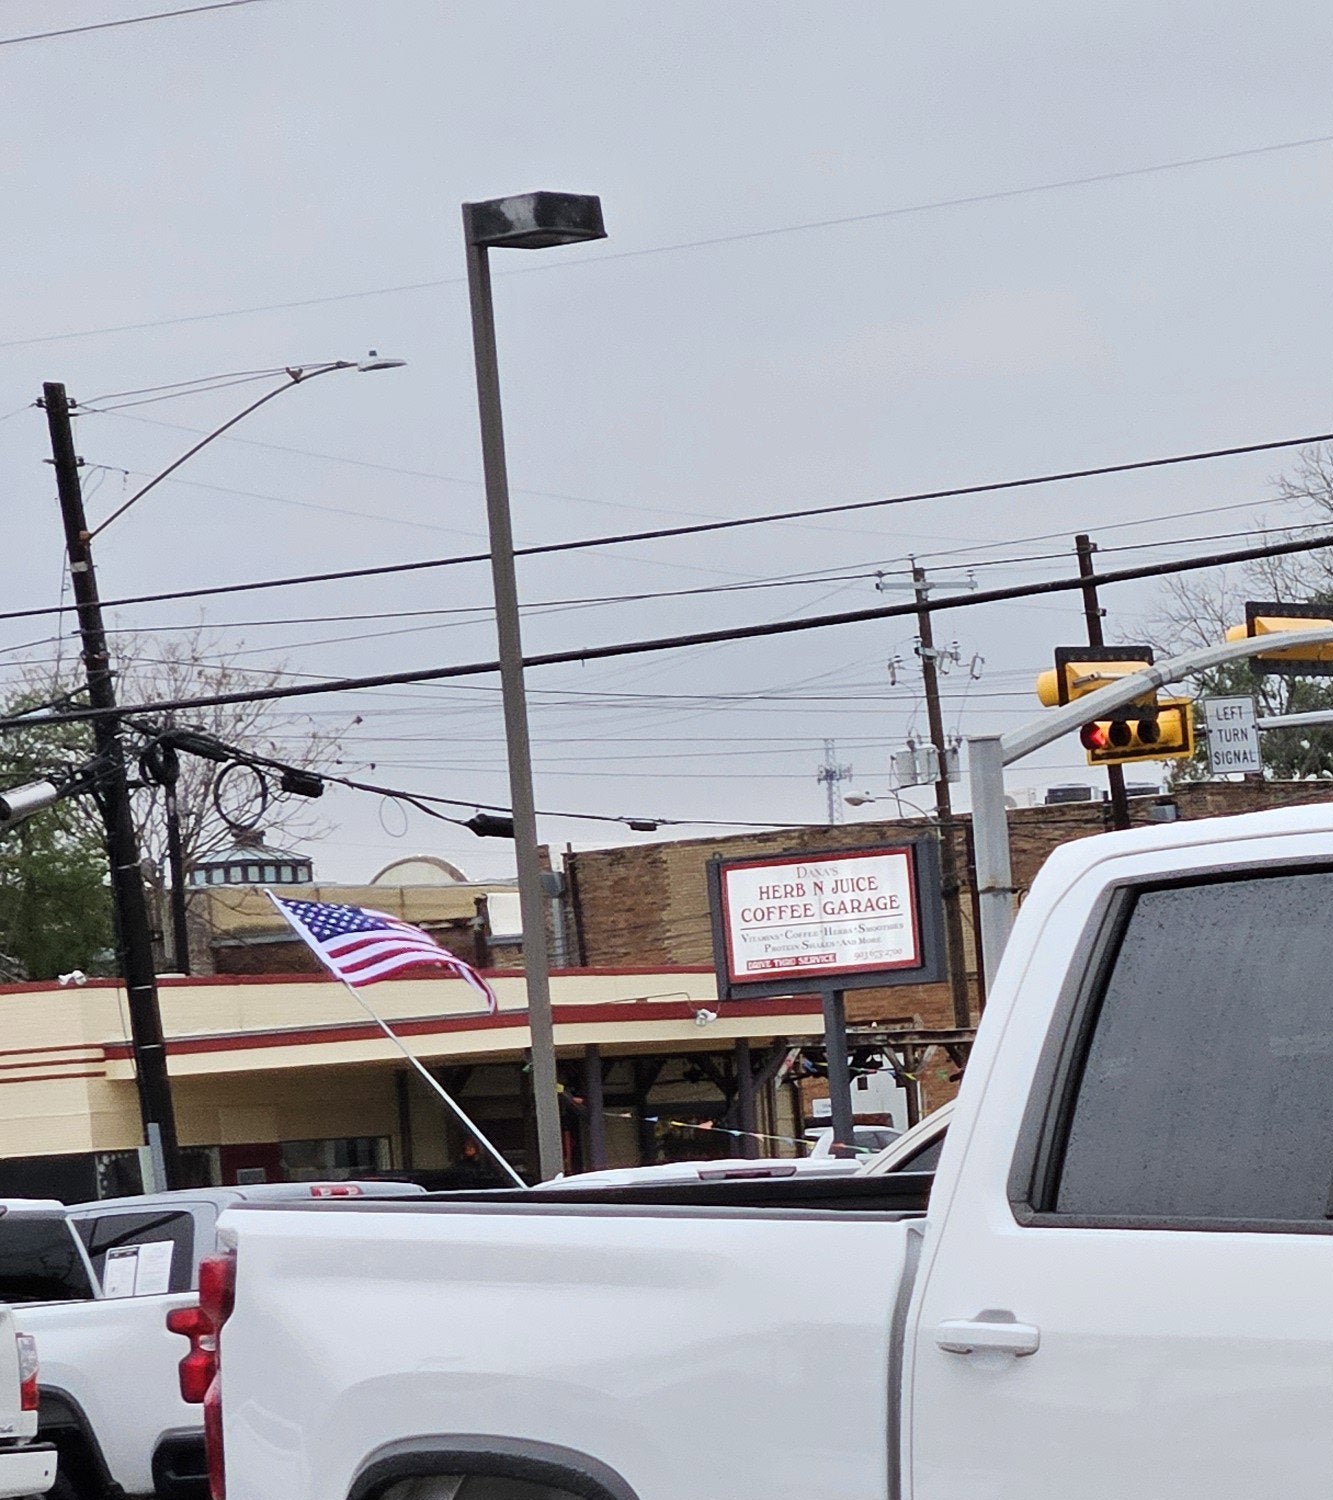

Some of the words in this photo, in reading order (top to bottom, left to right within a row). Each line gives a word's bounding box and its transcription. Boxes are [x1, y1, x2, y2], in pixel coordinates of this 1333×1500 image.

[1215, 705, 1243, 721] LEFT
[1217, 727, 1249, 743] TURN
[1214, 749, 1257, 765] SIGNAL
[758, 883, 806, 900] HERB
[812, 880, 825, 896] N
[831, 876, 879, 894] JUICE
[740, 903, 815, 922] COFFEE
[822, 894, 901, 916] GARAGE
